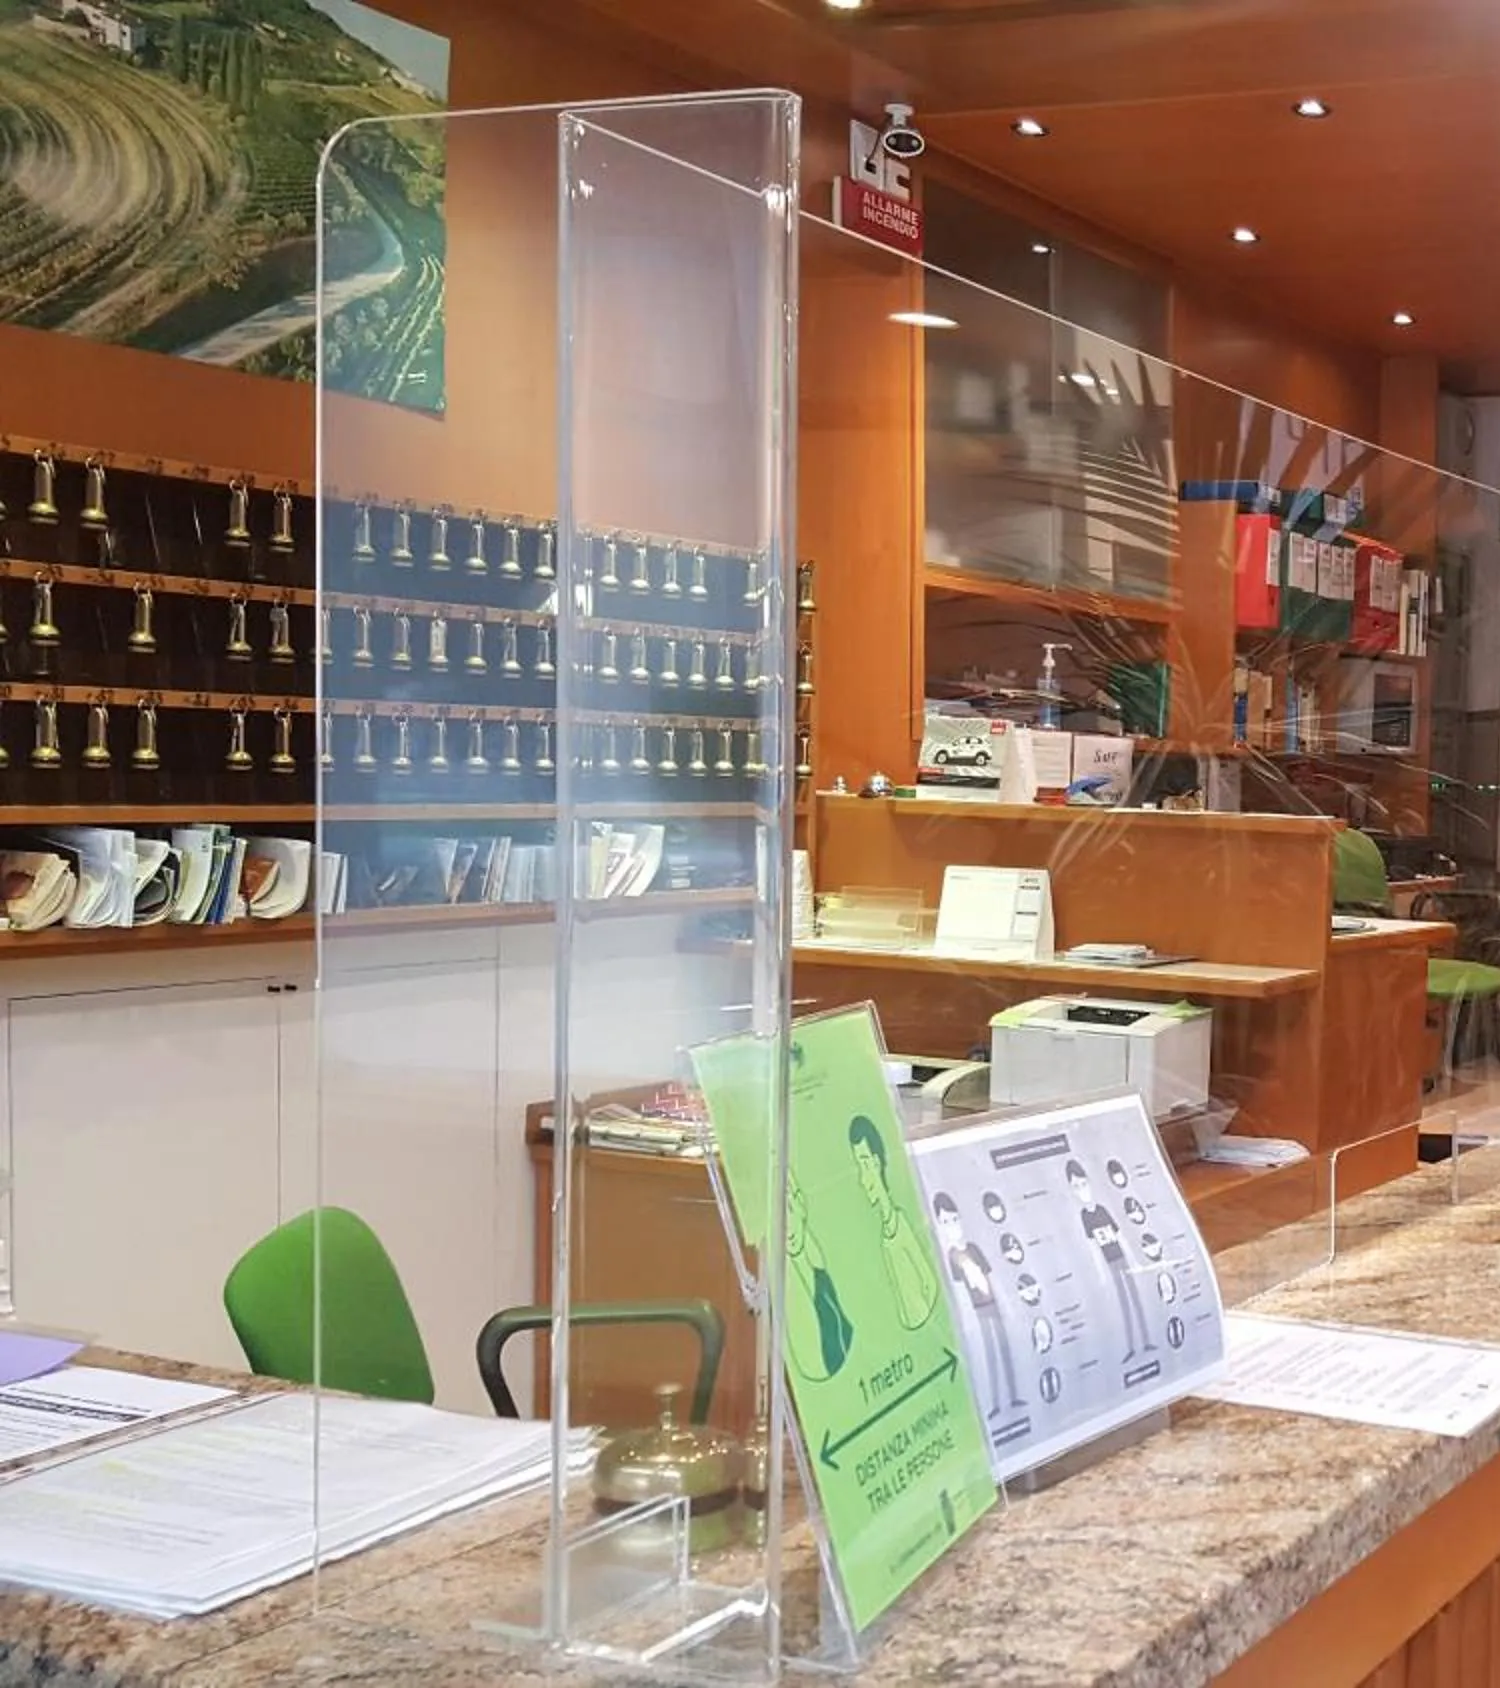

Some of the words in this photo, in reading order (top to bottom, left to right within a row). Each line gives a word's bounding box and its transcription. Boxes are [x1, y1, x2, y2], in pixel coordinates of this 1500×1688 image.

[862, 191, 919, 225] ALLARME
[862, 205, 919, 240] INCENDIO
[859, 1375, 869, 1407] 1
[870, 1353, 914, 1398] metro
[855, 1430, 912, 1487] DISTANZA
[910, 1399, 949, 1443] MINIMA
[866, 1482, 893, 1514] TRA
[891, 1467, 907, 1495] LE
[905, 1429, 955, 1481] PERSONE
